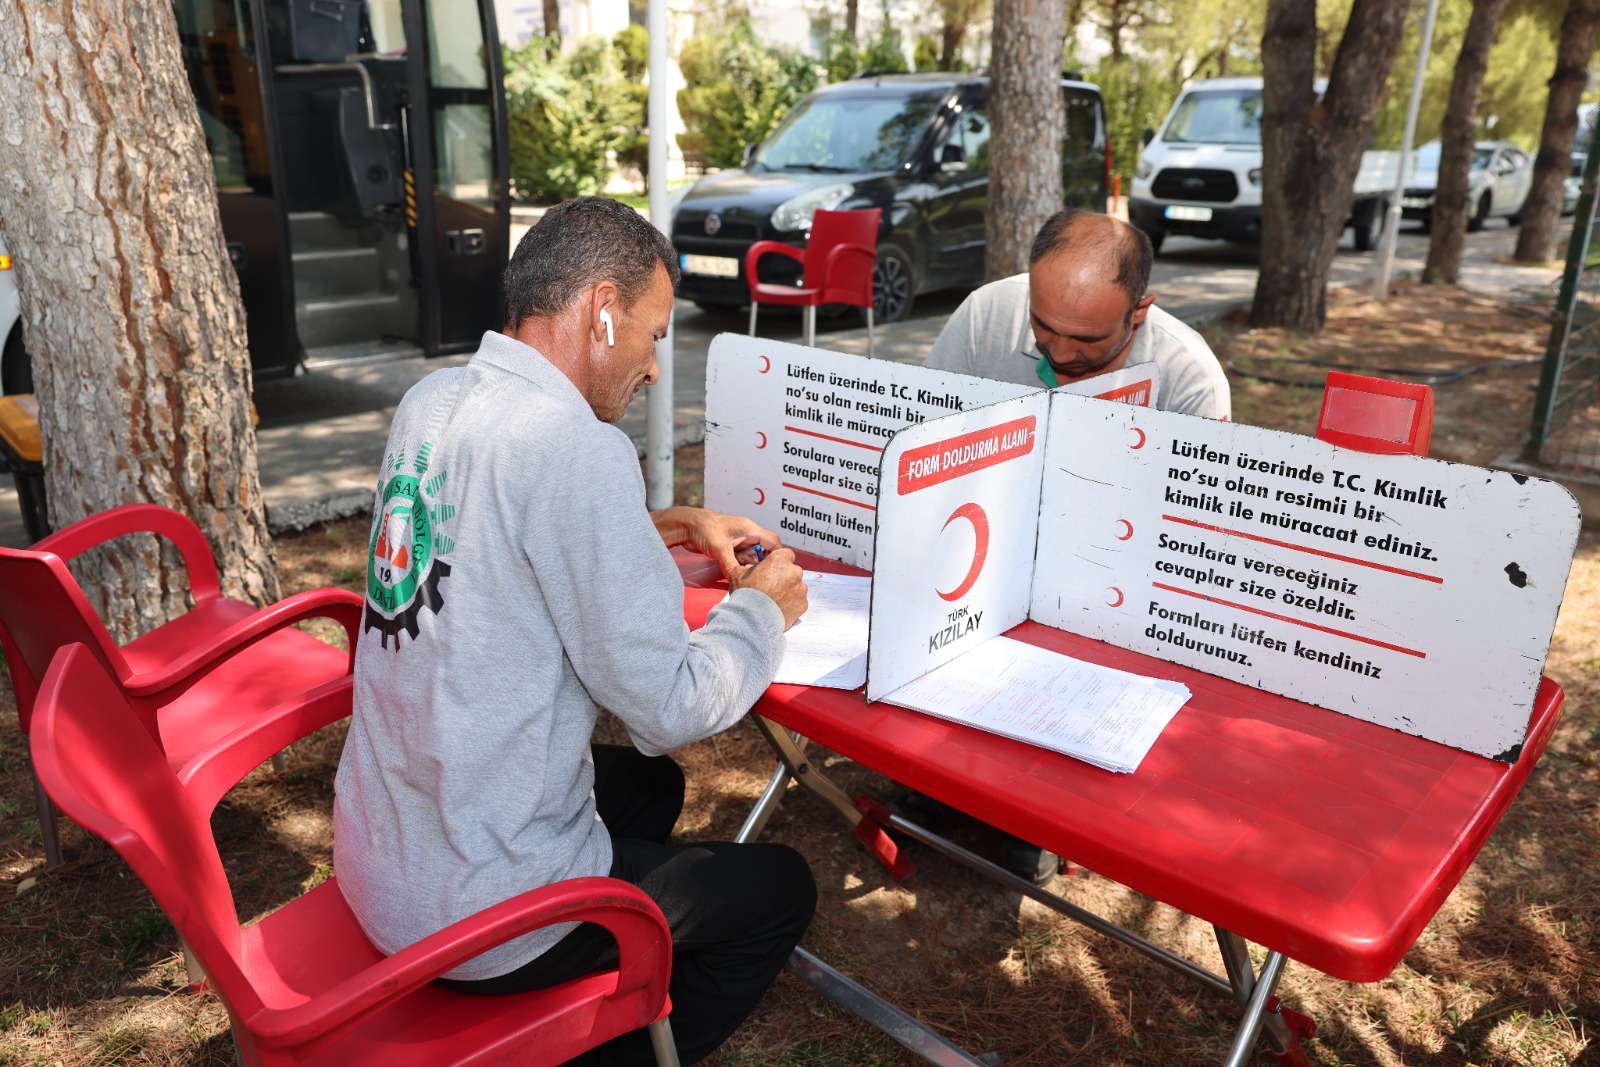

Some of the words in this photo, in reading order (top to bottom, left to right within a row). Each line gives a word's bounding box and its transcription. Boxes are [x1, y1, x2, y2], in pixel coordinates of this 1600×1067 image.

[787, 363, 825, 382] Lütfen
[829, 375, 886, 394] üzerinde
[890, 384, 912, 401] T.C.
[917, 389, 964, 411] Kimlik
[823, 391, 851, 408] olan
[855, 401, 902, 419] resimli
[906, 407, 925, 424] bir
[785, 402, 823, 422] kimlik
[827, 412, 843, 426] ile
[848, 420, 896, 438] müraca
[783, 441, 835, 465] Sorulara
[839, 458, 879, 477] verece
[908, 453, 940, 481] FORM
[942, 436, 999, 470] DOLDURMA
[1001, 427, 1028, 452] ALANI
[782, 464, 835, 484] cevaplar
[837, 476, 863, 491] size
[1224, 476, 1269, 498] olan
[1353, 500, 1385, 522] bir
[1236, 452, 1325, 484] üzerinde
[1332, 469, 1366, 492] T.C.
[1373, 478, 1448, 508] Kimlik
[780, 517, 851, 548] doldurunuz.
[781, 497, 831, 522] Formları
[835, 512, 873, 534] lütfen
[1164, 485, 1224, 513] kimlik
[1229, 501, 1254, 519] ile
[1259, 511, 1359, 543] müracaat
[1363, 533, 1438, 561] ediniz.
[1158, 533, 1237, 565] Sorulara
[1243, 557, 1359, 595] vereceğiniz
[1155, 560, 1235, 588] cevaplar
[1239, 579, 1277, 599] size
[1282, 588, 1356, 620] özeldir.
[928, 611, 984, 654] KIZILAY
[947, 605, 969, 624] TÜRK
[1145, 623, 1253, 666] doldurunuz.
[1148, 601, 1225, 634] Formları
[1230, 622, 1287, 652] lütfen
[1294, 640, 1382, 679] kendiniz
